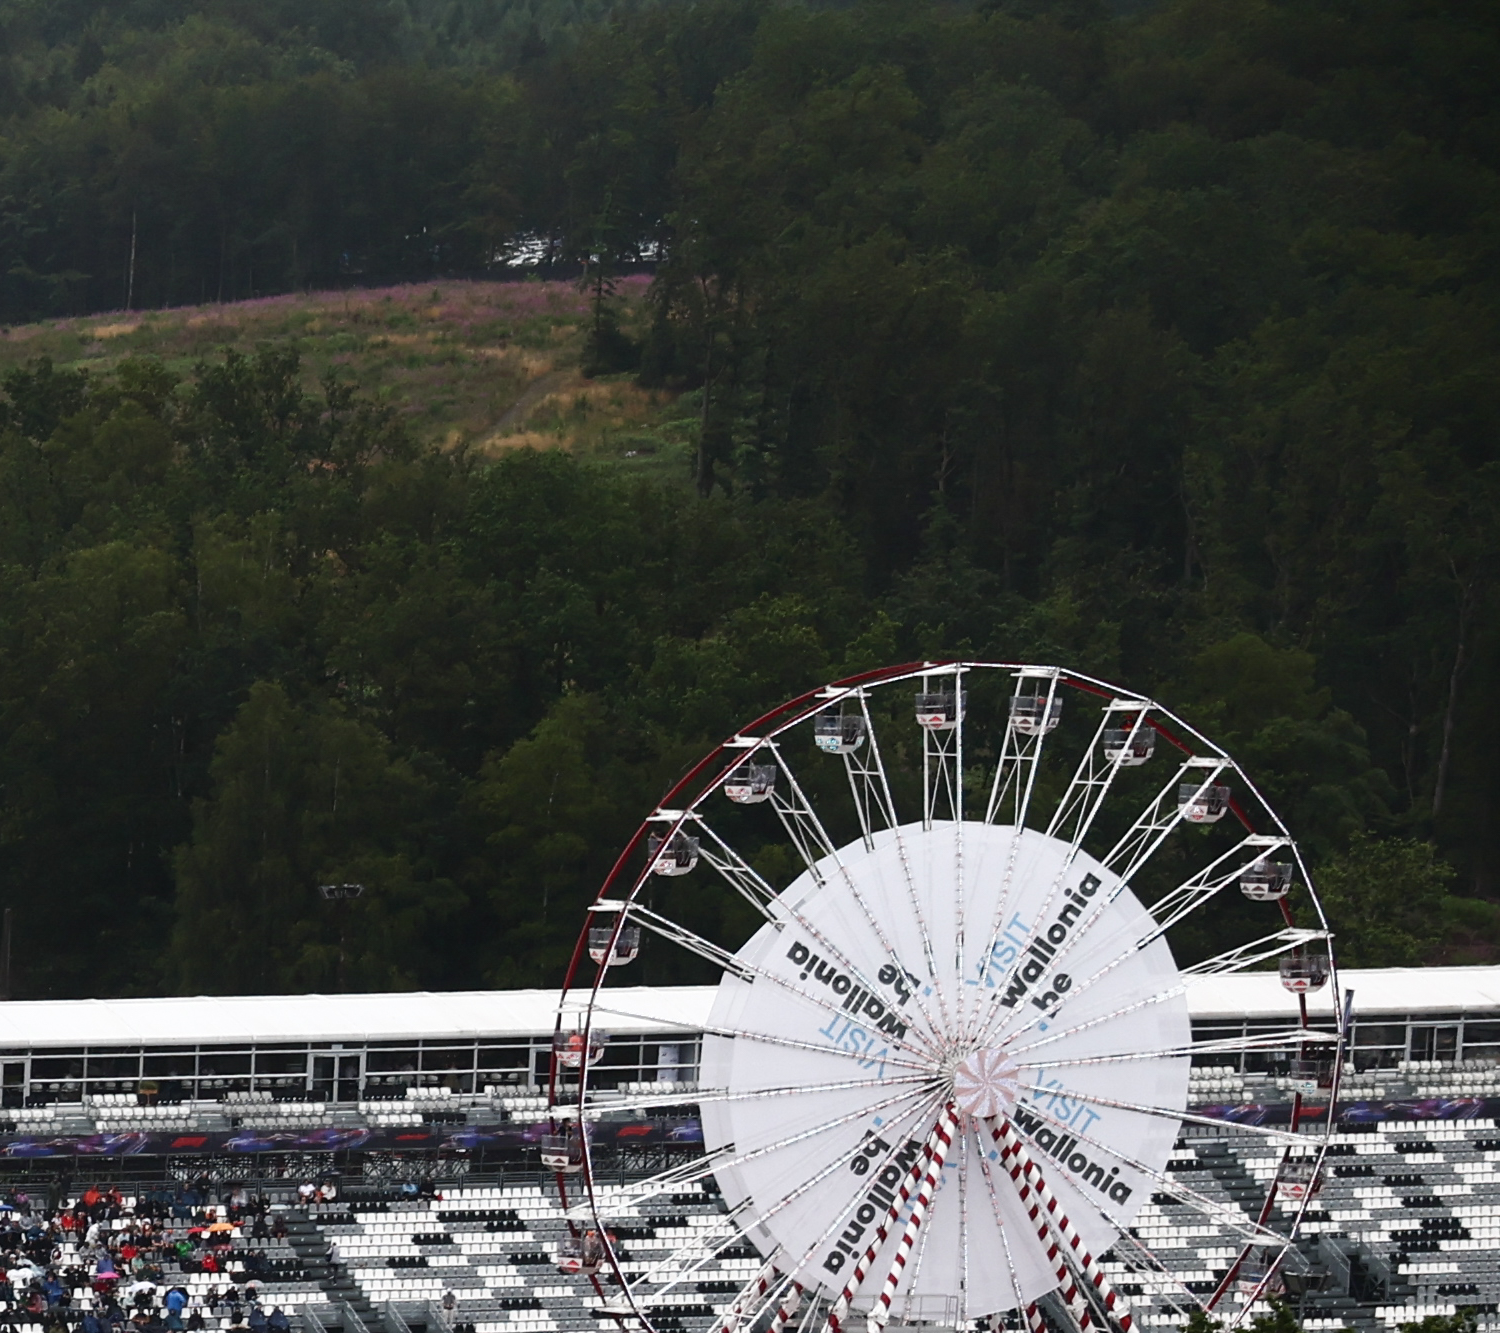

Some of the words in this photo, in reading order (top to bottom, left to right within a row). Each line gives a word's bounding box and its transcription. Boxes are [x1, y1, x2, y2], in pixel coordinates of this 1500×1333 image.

[965, 912, 1031, 989] VISIT
[992, 873, 1102, 1008] wallonia
[786, 941, 908, 1051] wallonia
[1013, 1098, 1133, 1206] wallonia
[1033, 1069, 1101, 1135] VISIT
